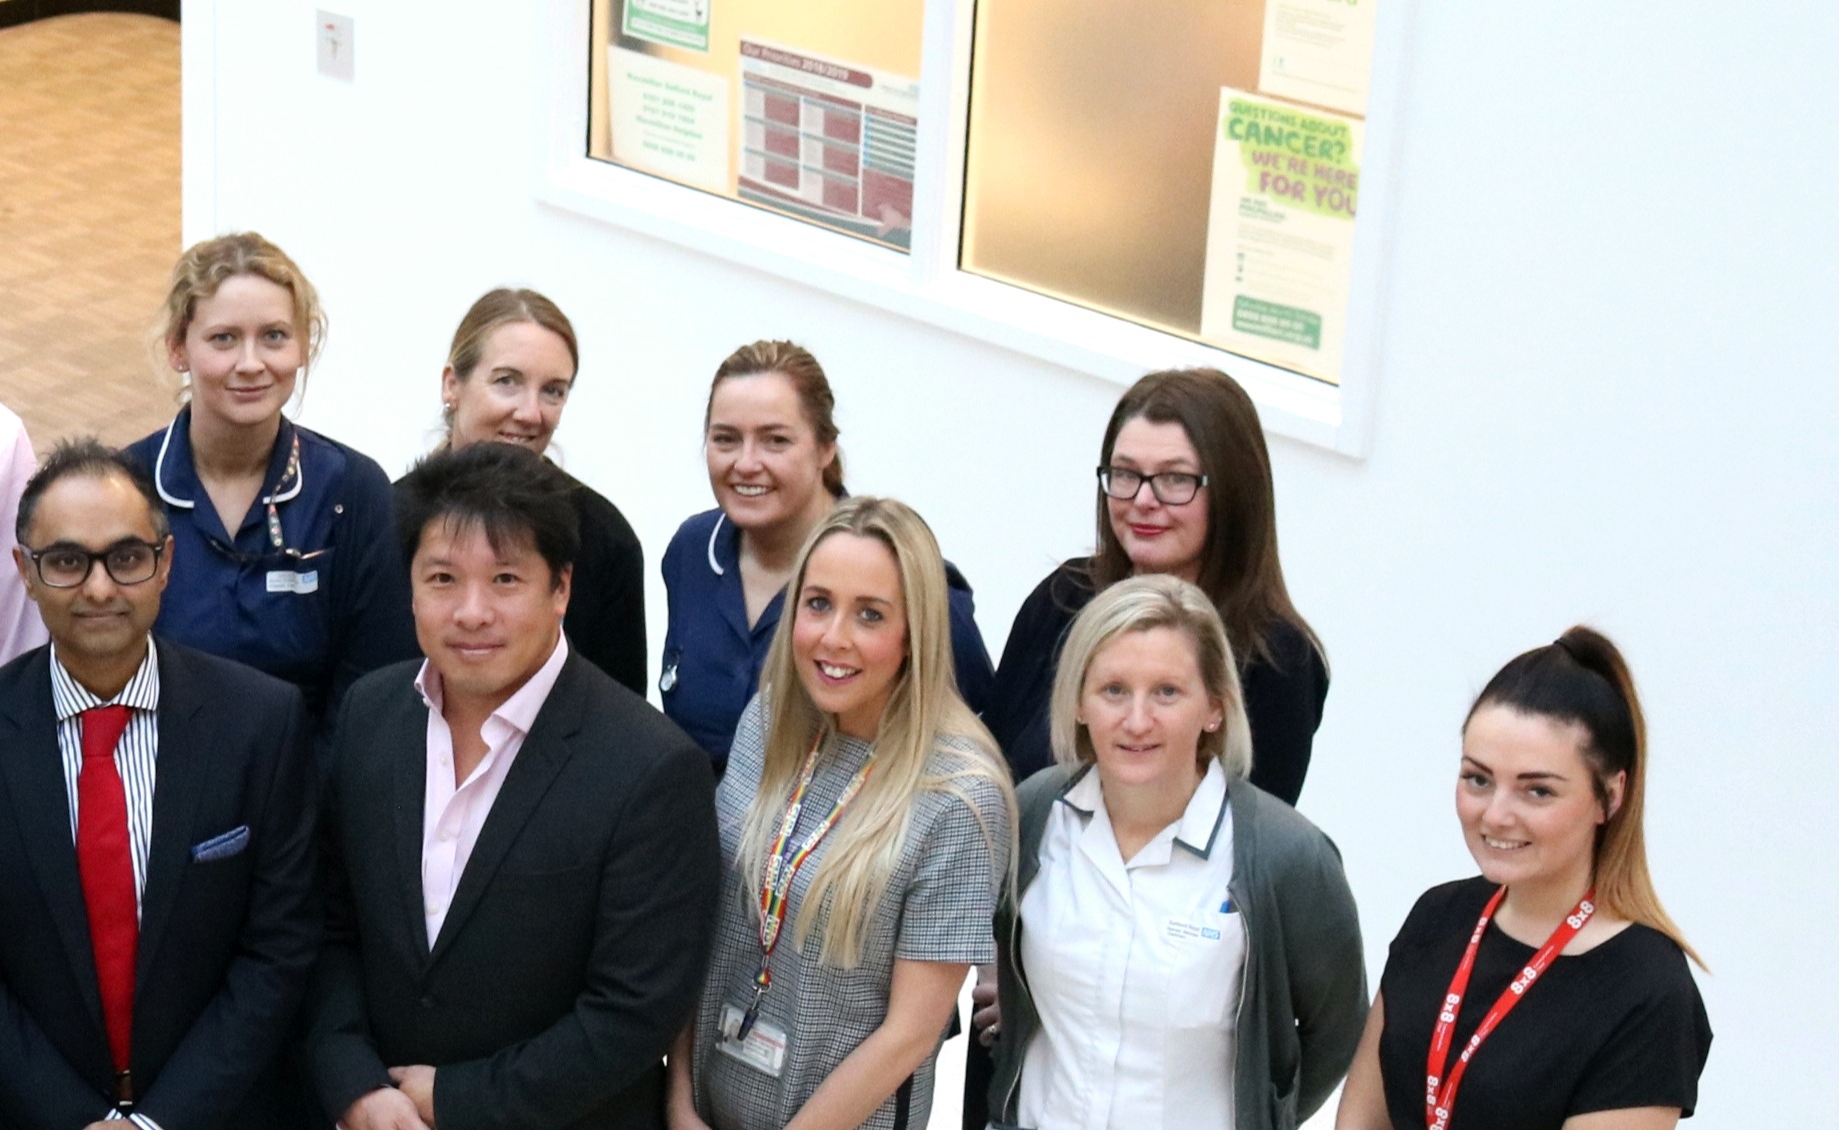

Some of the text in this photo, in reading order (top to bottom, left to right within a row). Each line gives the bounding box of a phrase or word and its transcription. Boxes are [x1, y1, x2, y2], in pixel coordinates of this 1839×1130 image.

[1229, 117, 1346, 164] CANCER?
[1300, 118, 1347, 139] ABOUT
[1260, 170, 1306, 203] FOR
[1313, 162, 1358, 191] HERE
[1567, 900, 1594, 929] 8x8
[1510, 966, 1537, 995] 8x8
[1440, 993, 1460, 1023] 8x8
[1426, 1075, 1439, 1106] 8x8
